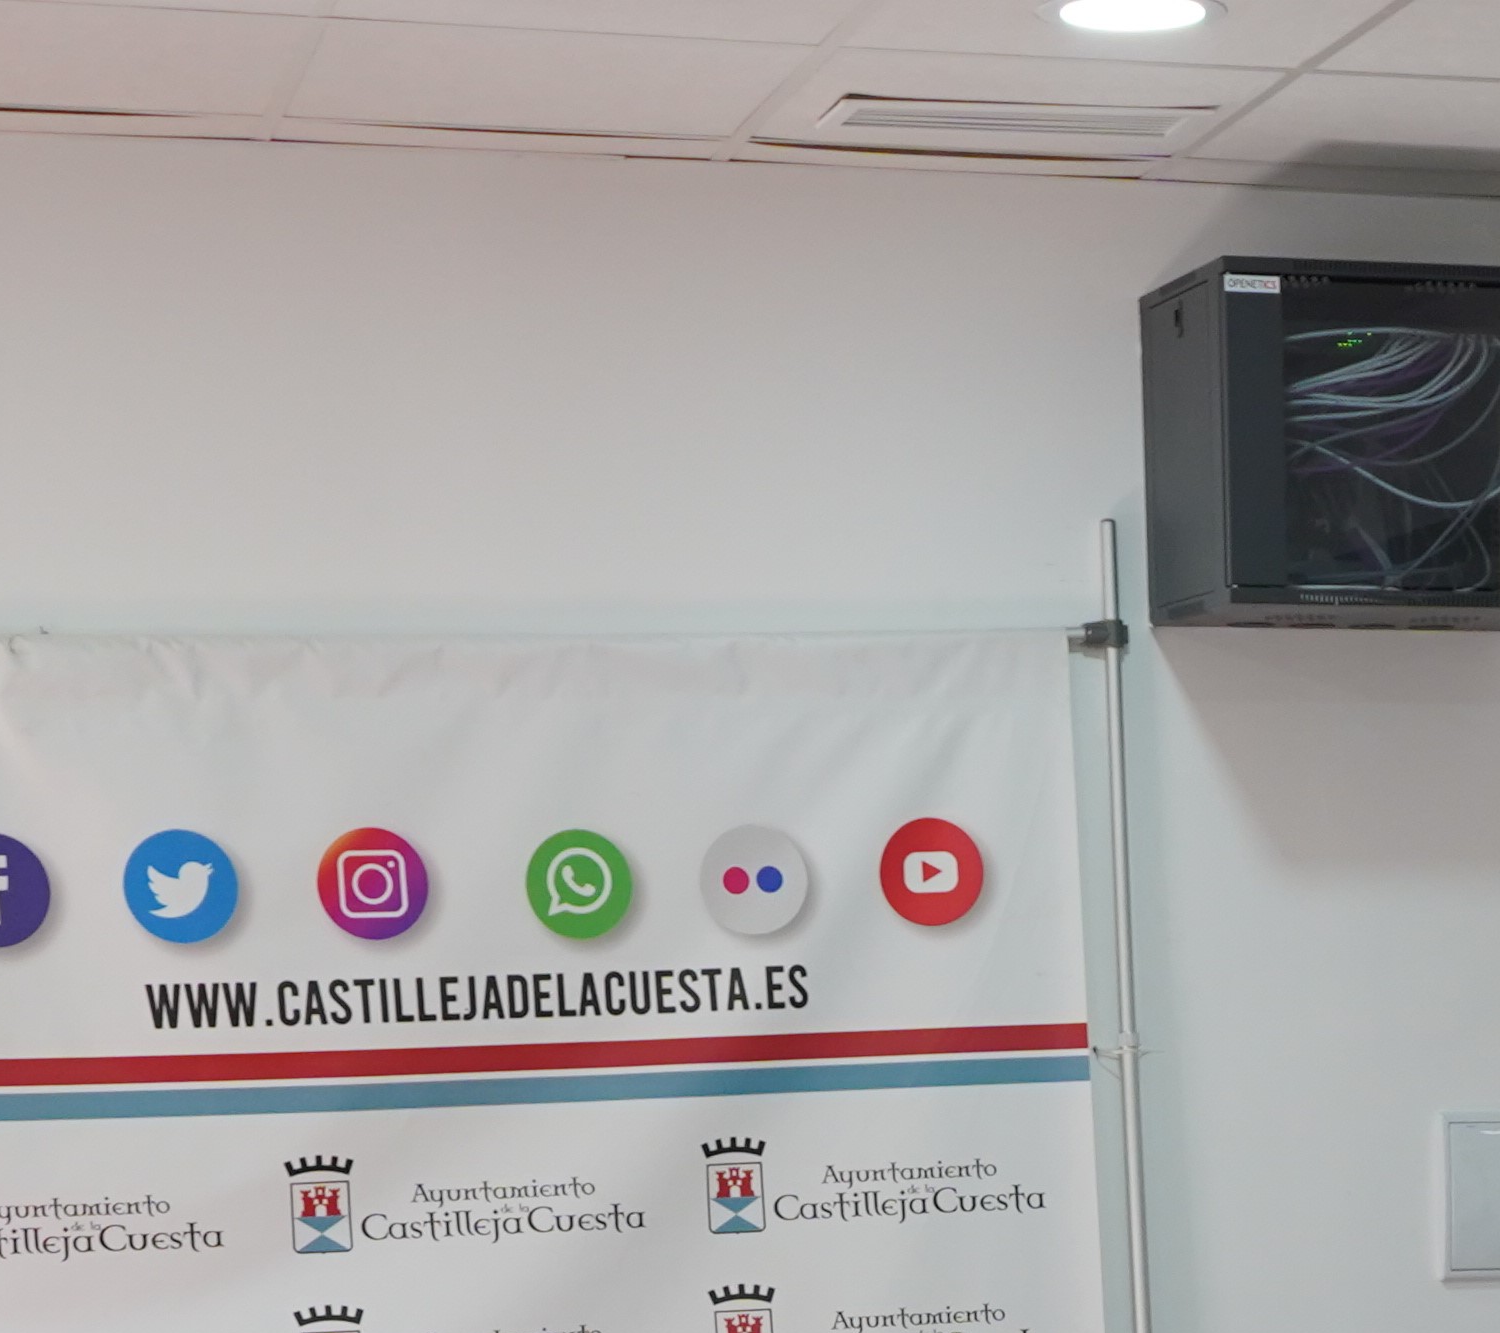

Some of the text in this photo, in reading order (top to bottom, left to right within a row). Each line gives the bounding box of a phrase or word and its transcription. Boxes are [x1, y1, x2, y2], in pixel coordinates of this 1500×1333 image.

[145, 964, 810, 1031] WWW.CASTILLEJADELACUESTA.ES
[822, 1158, 997, 1189] Ayuntamiento
[411, 1177, 595, 1208] Ayuntamiento
[831, 1303, 1005, 1333] Ayuntamiento
